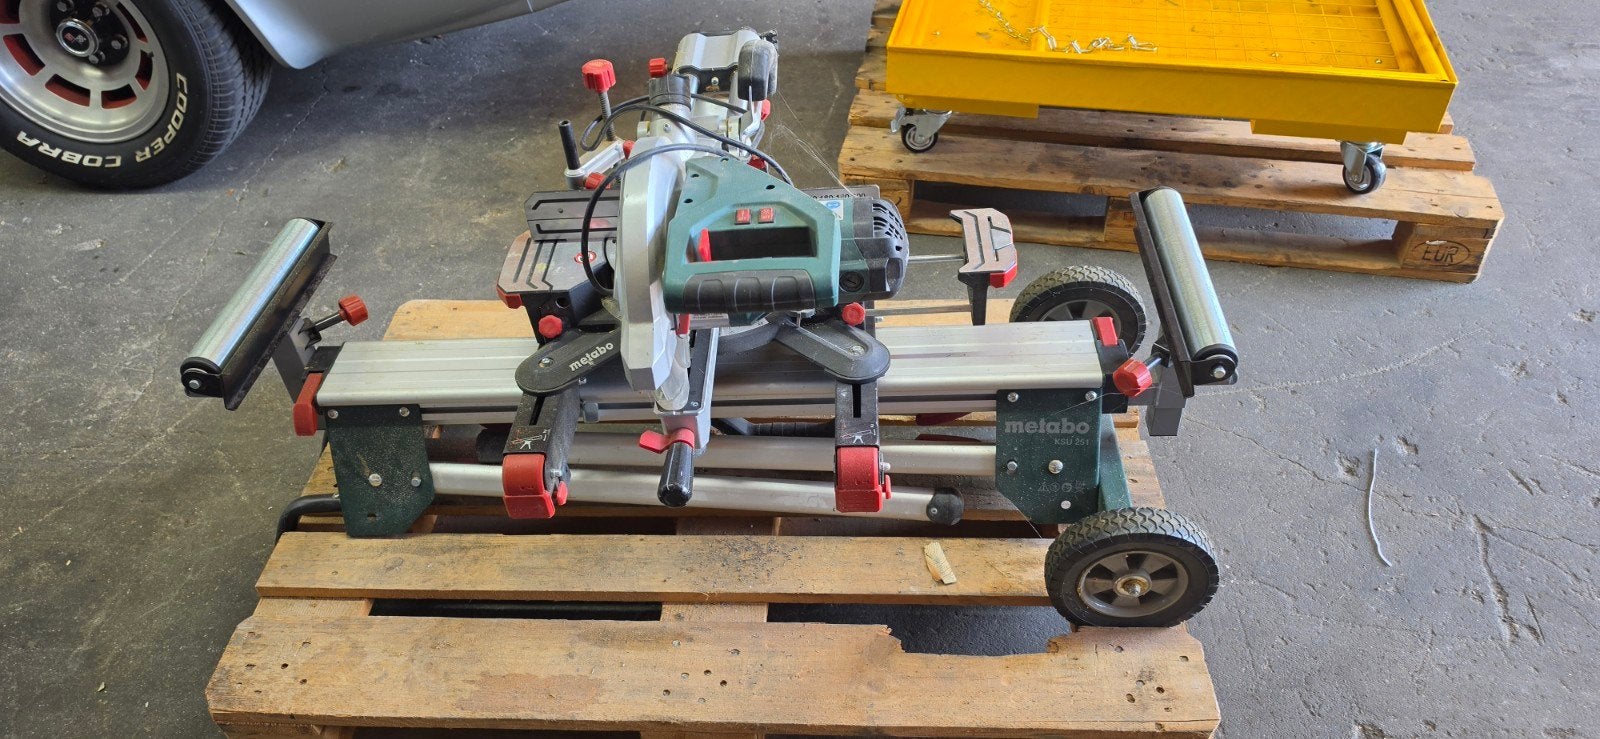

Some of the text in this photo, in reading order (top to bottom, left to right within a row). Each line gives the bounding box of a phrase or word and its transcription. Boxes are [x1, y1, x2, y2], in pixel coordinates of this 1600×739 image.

[16, 73, 188, 168] COOPER COBRA
[1422, 246, 1459, 262] EUR
[569, 343, 614, 371] metabo
[1005, 418, 1090, 434] metabo
[1054, 438, 1073, 446] KSU
